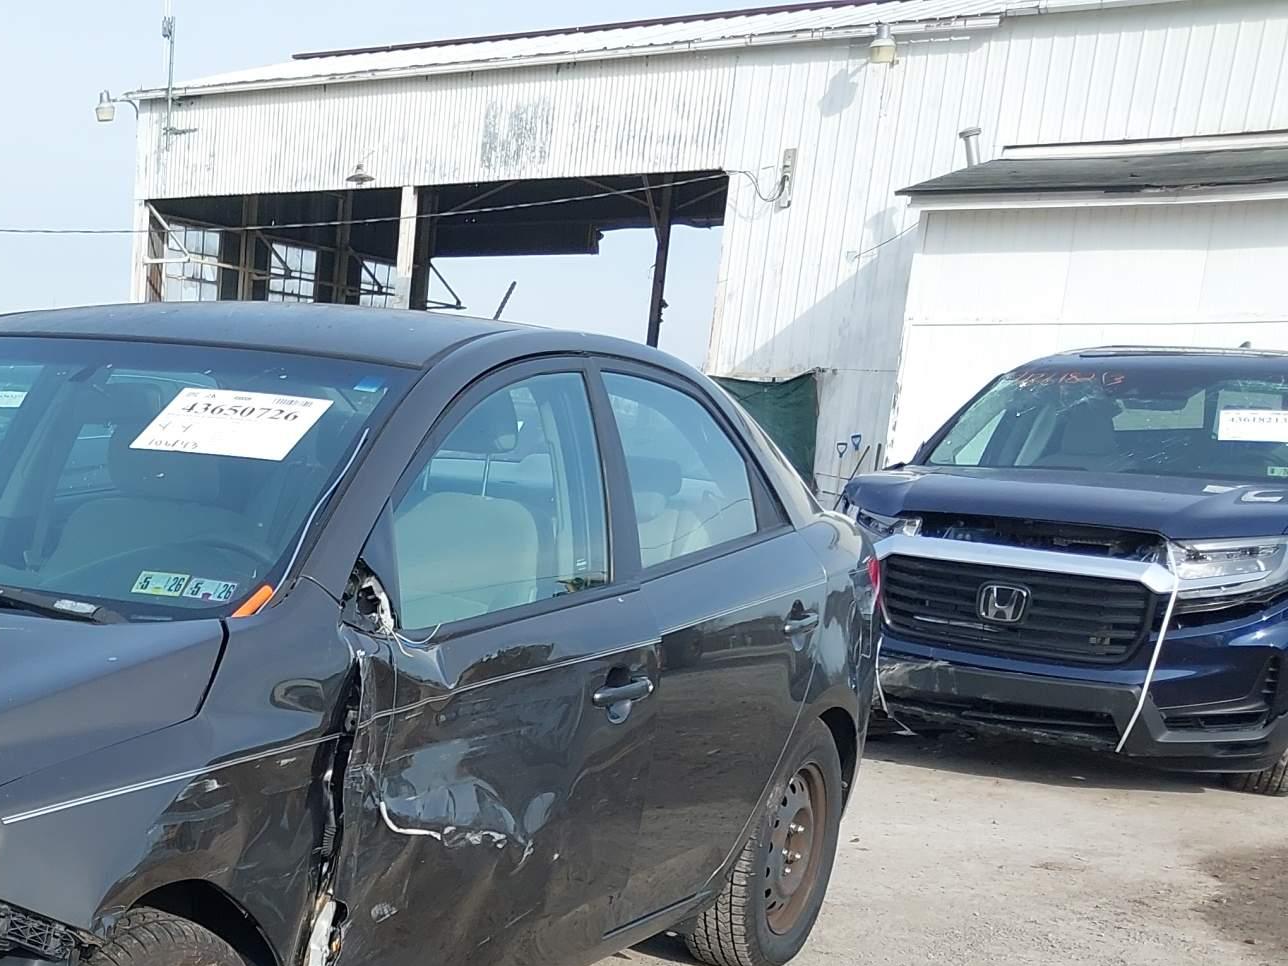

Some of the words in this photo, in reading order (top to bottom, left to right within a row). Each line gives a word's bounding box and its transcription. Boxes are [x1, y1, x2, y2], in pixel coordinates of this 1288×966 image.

[182, 402, 299, 422] 43650726
[167, 576, 185, 592] 26
[217, 583, 235, 600] 26
